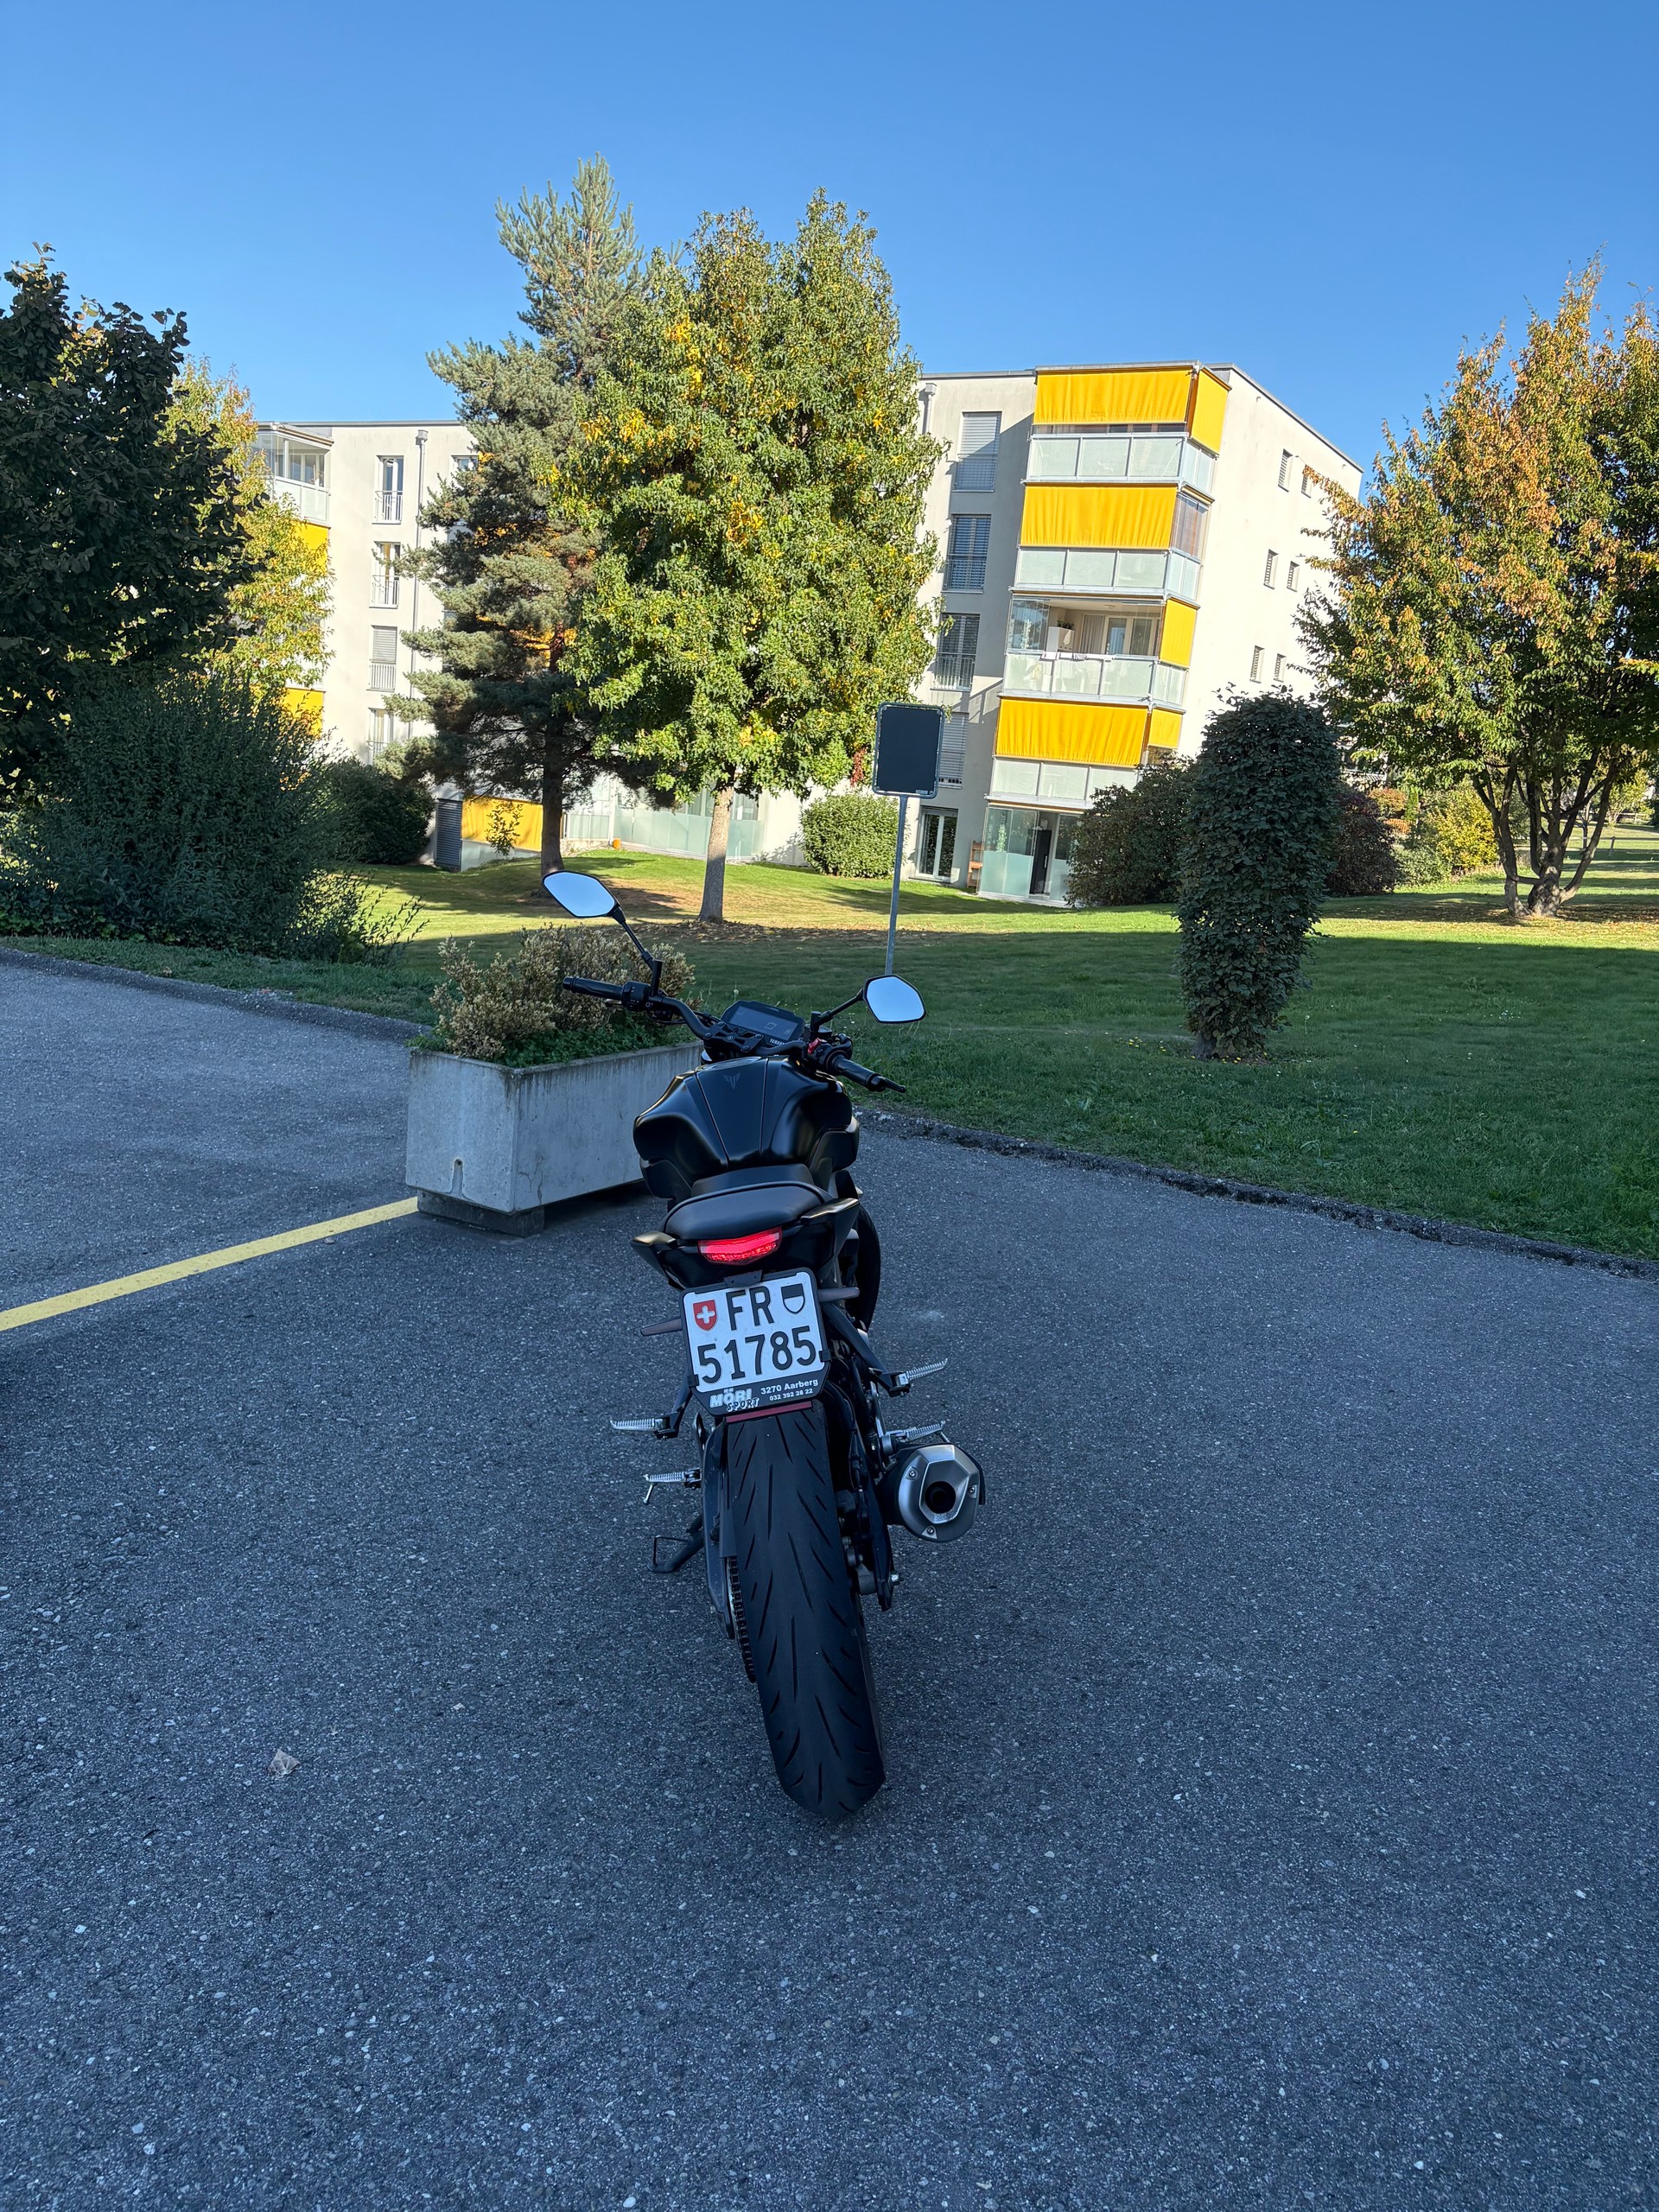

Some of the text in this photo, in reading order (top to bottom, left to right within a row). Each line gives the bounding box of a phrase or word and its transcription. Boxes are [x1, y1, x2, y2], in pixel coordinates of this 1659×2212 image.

[726, 1286, 774, 1331] FR
[697, 1325, 816, 1383] 51785
[760, 1379, 818, 1395] 3270 Aarberg
[710, 1388, 753, 1408] MÖRI
[727, 1397, 760, 1412] SPORT
[769, 1393, 781, 1402] 032
[782, 1391, 795, 1400] 392
